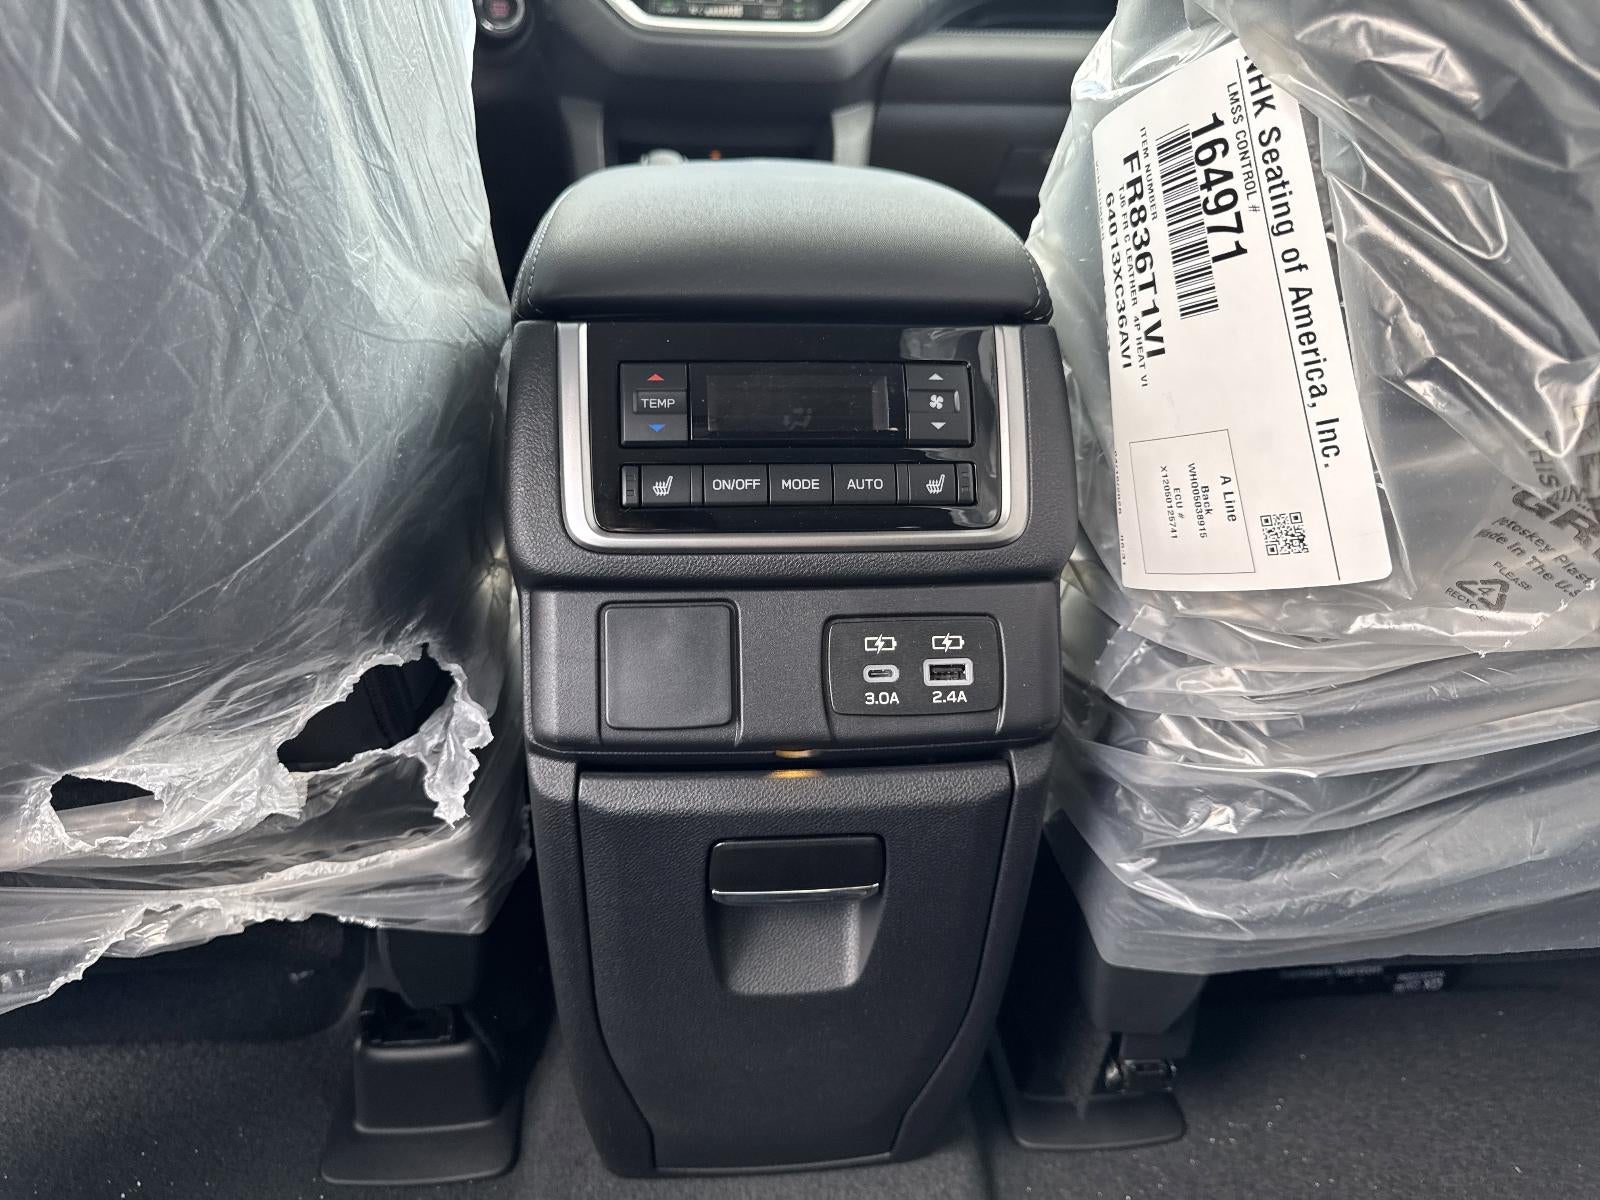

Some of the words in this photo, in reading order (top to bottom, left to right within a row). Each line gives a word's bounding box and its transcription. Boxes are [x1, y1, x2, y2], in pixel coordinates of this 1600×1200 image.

[1226, 81, 1245, 124] LMSS
[1139, 126, 1149, 159] ITEM
[1145, 163, 1158, 221] NUMBER
[1235, 130, 1258, 199] CONTROL
[1191, 112, 1248, 263] 164971
[1258, 126, 1296, 237] Seating
[1122, 212, 1129, 230] FR
[1123, 150, 1166, 358] FR836T1VI
[1124, 234, 1130, 243] C
[1281, 247, 1309, 274] of
[1106, 192, 1132, 369] 64013XC36AVI
[1125, 247, 1138, 307] LEATHER
[1136, 337, 1146, 369] HEAT
[1288, 286, 1328, 408] America,
[641, 398, 675, 409] TEMP
[1315, 417, 1341, 468] Inc.
[712, 478, 761, 491] ON/OFF
[781, 479, 820, 491] MODE
[847, 478, 884, 490] AUTO
[1220, 475, 1232, 485] A
[1173, 487, 1184, 509] ECU
[1200, 485, 1213, 515] Back
[1223, 491, 1237, 522] Line
[1493, 560, 1533, 592] PLEASE
[865, 692, 900, 705] 3.0A
[932, 691, 968, 703] 2.4A
